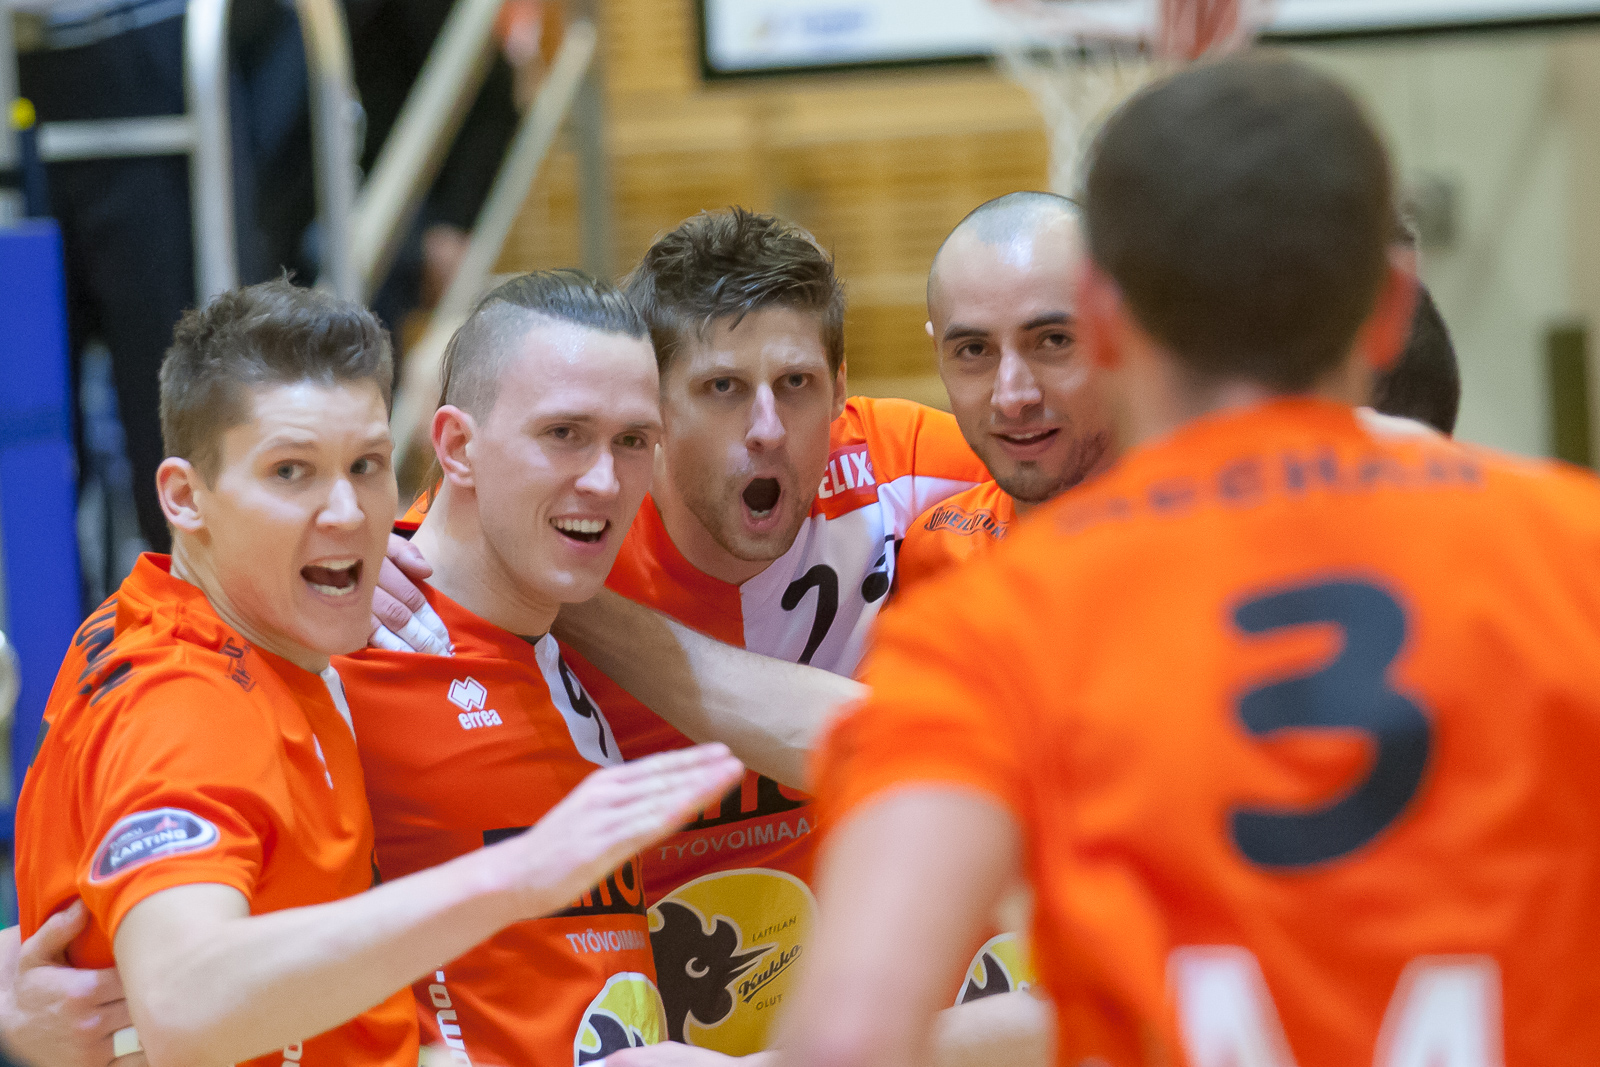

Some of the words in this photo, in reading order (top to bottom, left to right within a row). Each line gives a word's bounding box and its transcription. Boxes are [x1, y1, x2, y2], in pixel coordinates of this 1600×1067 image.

[1225, 571, 1436, 869] 3
[110, 829, 188, 868] KARTING
[752, 915, 797, 942] LAITILAN
[738, 945, 803, 999] Kukko
[755, 993, 783, 1011] OLUT
